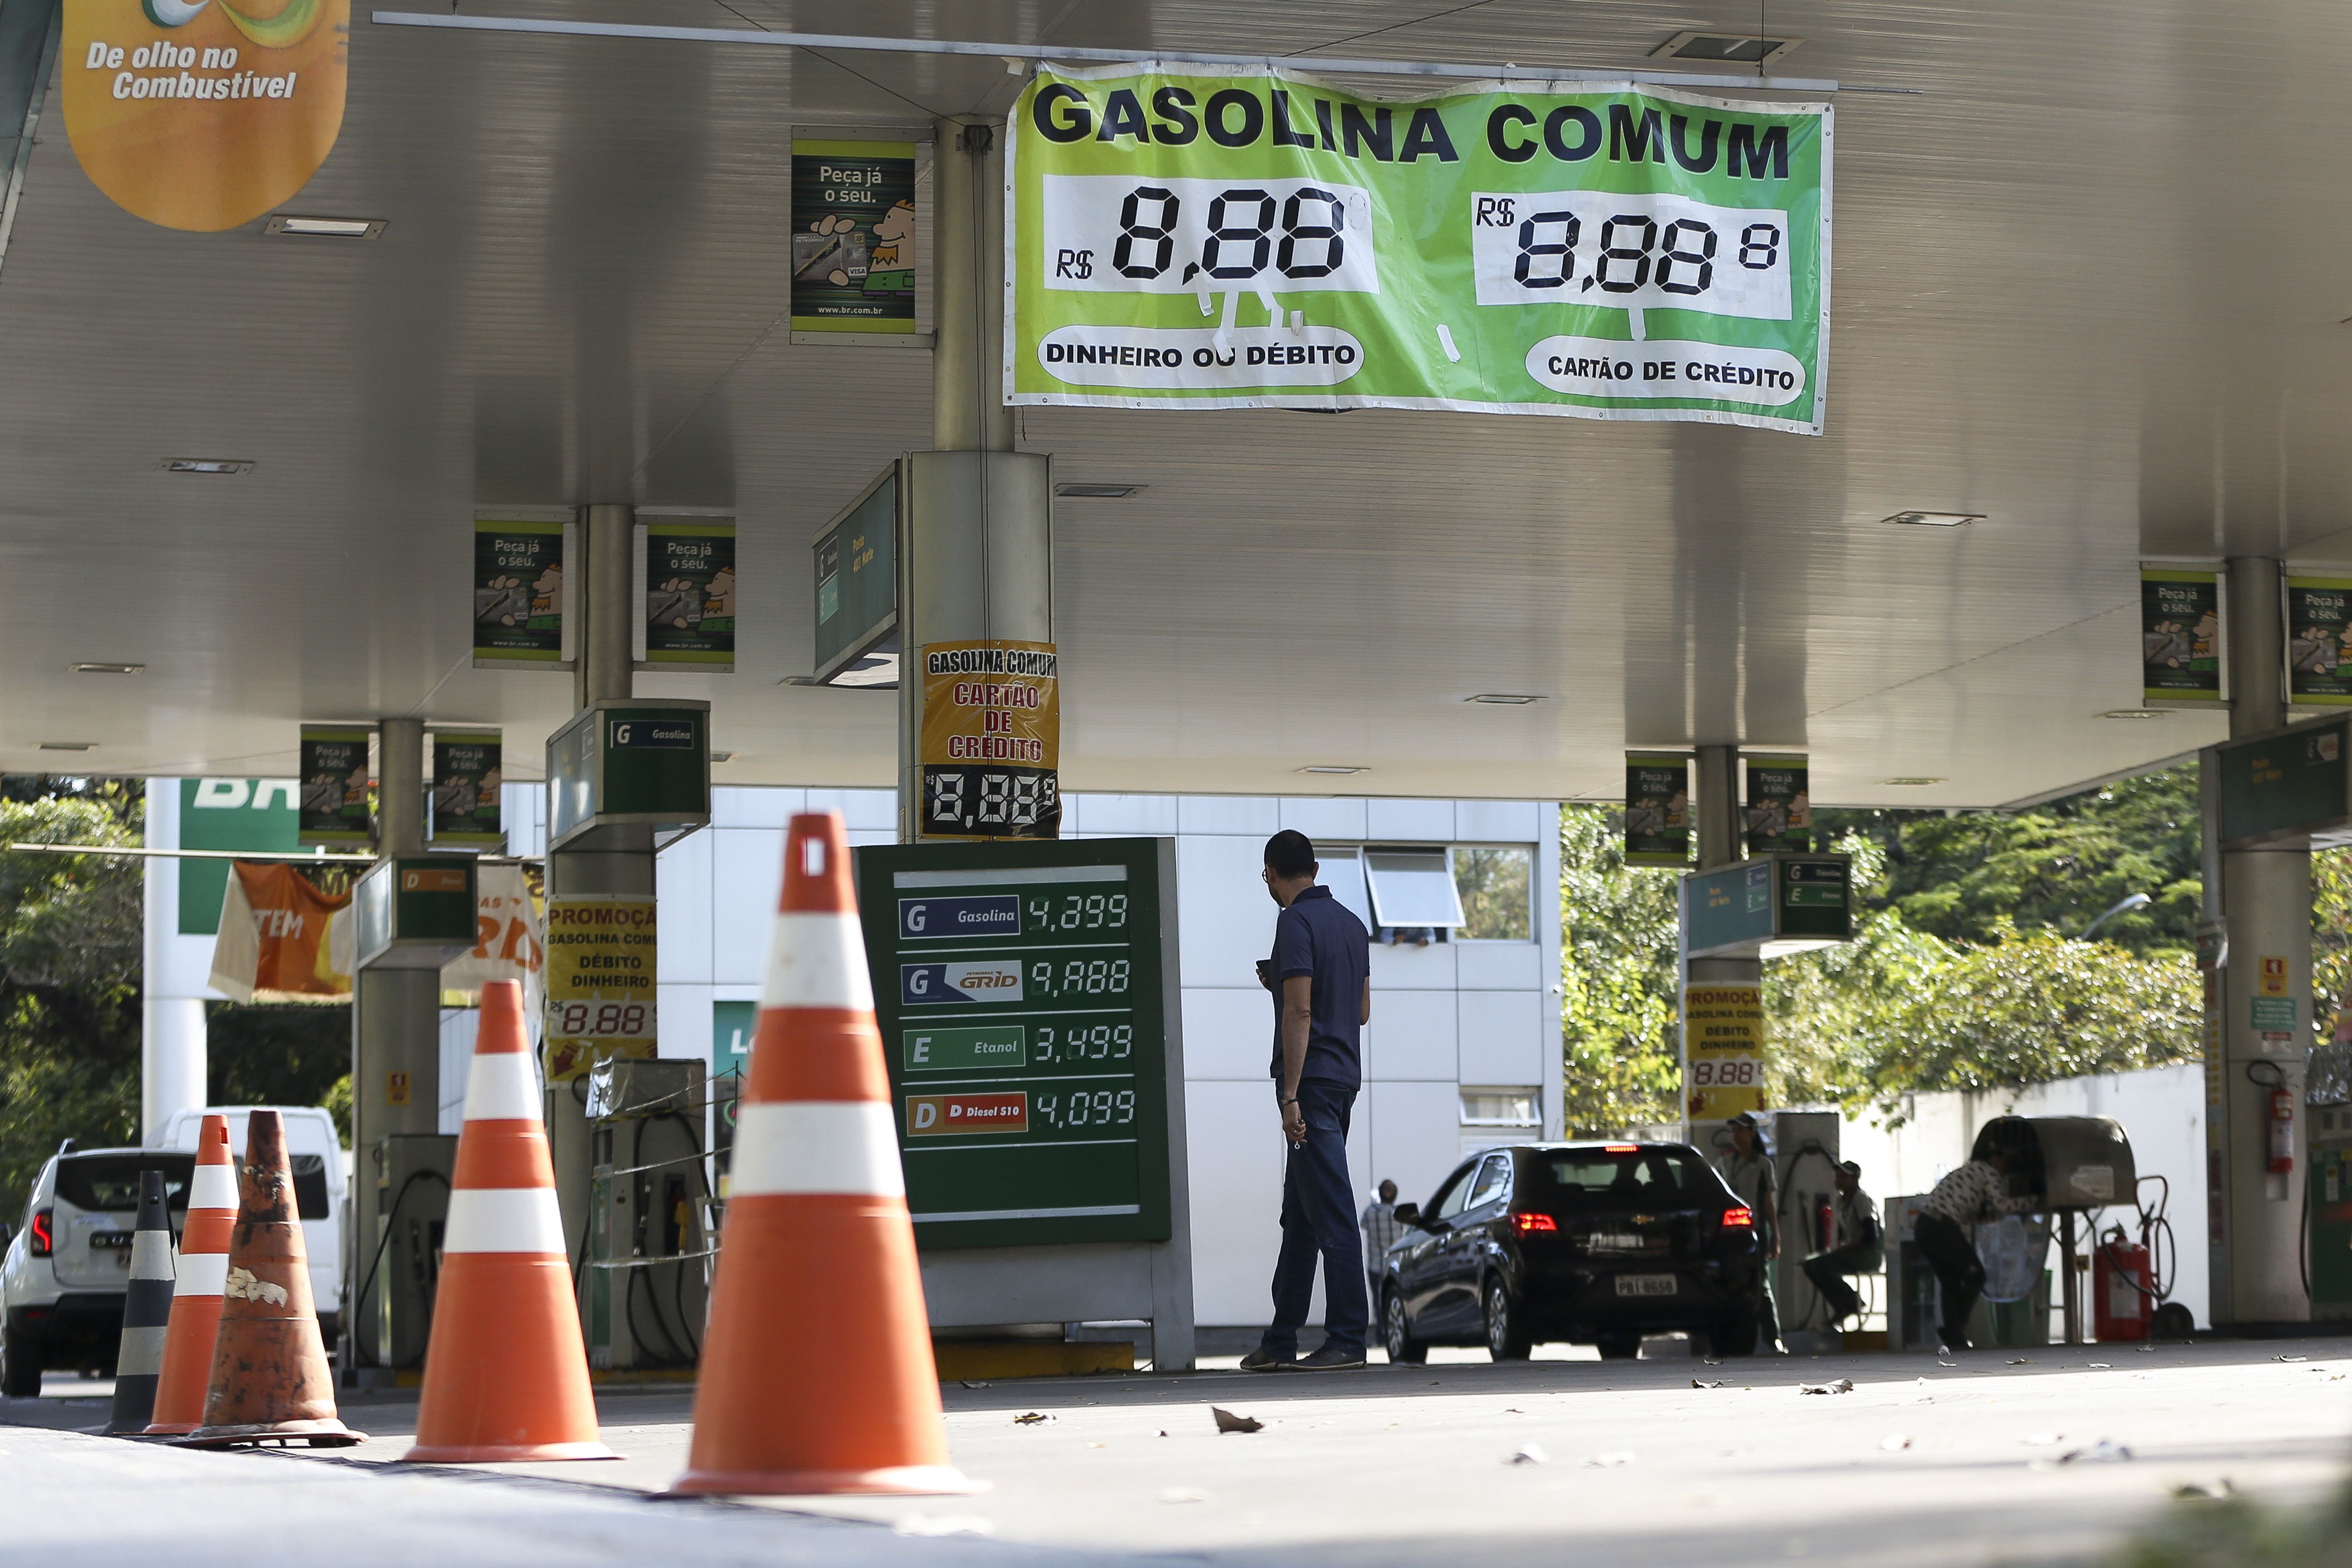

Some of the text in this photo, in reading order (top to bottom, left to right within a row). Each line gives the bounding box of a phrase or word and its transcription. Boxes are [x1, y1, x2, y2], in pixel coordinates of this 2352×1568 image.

[86, 41, 238, 69] De olho no
[112, 70, 297, 100] Combustível
[1032, 83, 1790, 180] GASOLINA COMUM
[820, 166, 882, 187] Peça já
[825, 189, 877, 203] o seu.
[1475, 197, 1515, 227] R$
[1055, 186, 1345, 286] R$ 8,88
[818, 306, 883, 315] www.br.com.br
[1046, 343, 1183, 368] DINHEIRO
[1246, 341, 1356, 366] DÉBITO
[1548, 355, 1795, 391] CARTÃO DE CRÉDITO
[495, 539, 539, 556] Peça já
[667, 543, 712, 559] Peça já
[498, 556, 535, 567] o seu.
[671, 559, 708, 569] o seu.
[929, 649, 1004, 675] GASOLINA
[953, 681, 1040, 709] CARTÃO
[617, 725, 691, 744] G Gasolina
[985, 710, 1012, 733] DE
[948, 731, 1043, 763] CRÉDITO
[407, 873, 419, 888] D
[1790, 865, 1801, 879] G
[1791, 888, 1802, 901] E
[907, 905, 926, 932] G
[958, 910, 1015, 924] Gasolina
[580, 954, 642, 969] DÉBITO
[572, 975, 649, 987] DINHEIRO
[910, 969, 929, 995] G
[959, 970, 1018, 989] GRID
[562, 1004, 646, 1036] 8,88
[912, 1025, 1132, 1063] E Etanol 3,499
[915, 1090, 1135, 1129] D D Diesel S10 4,099
